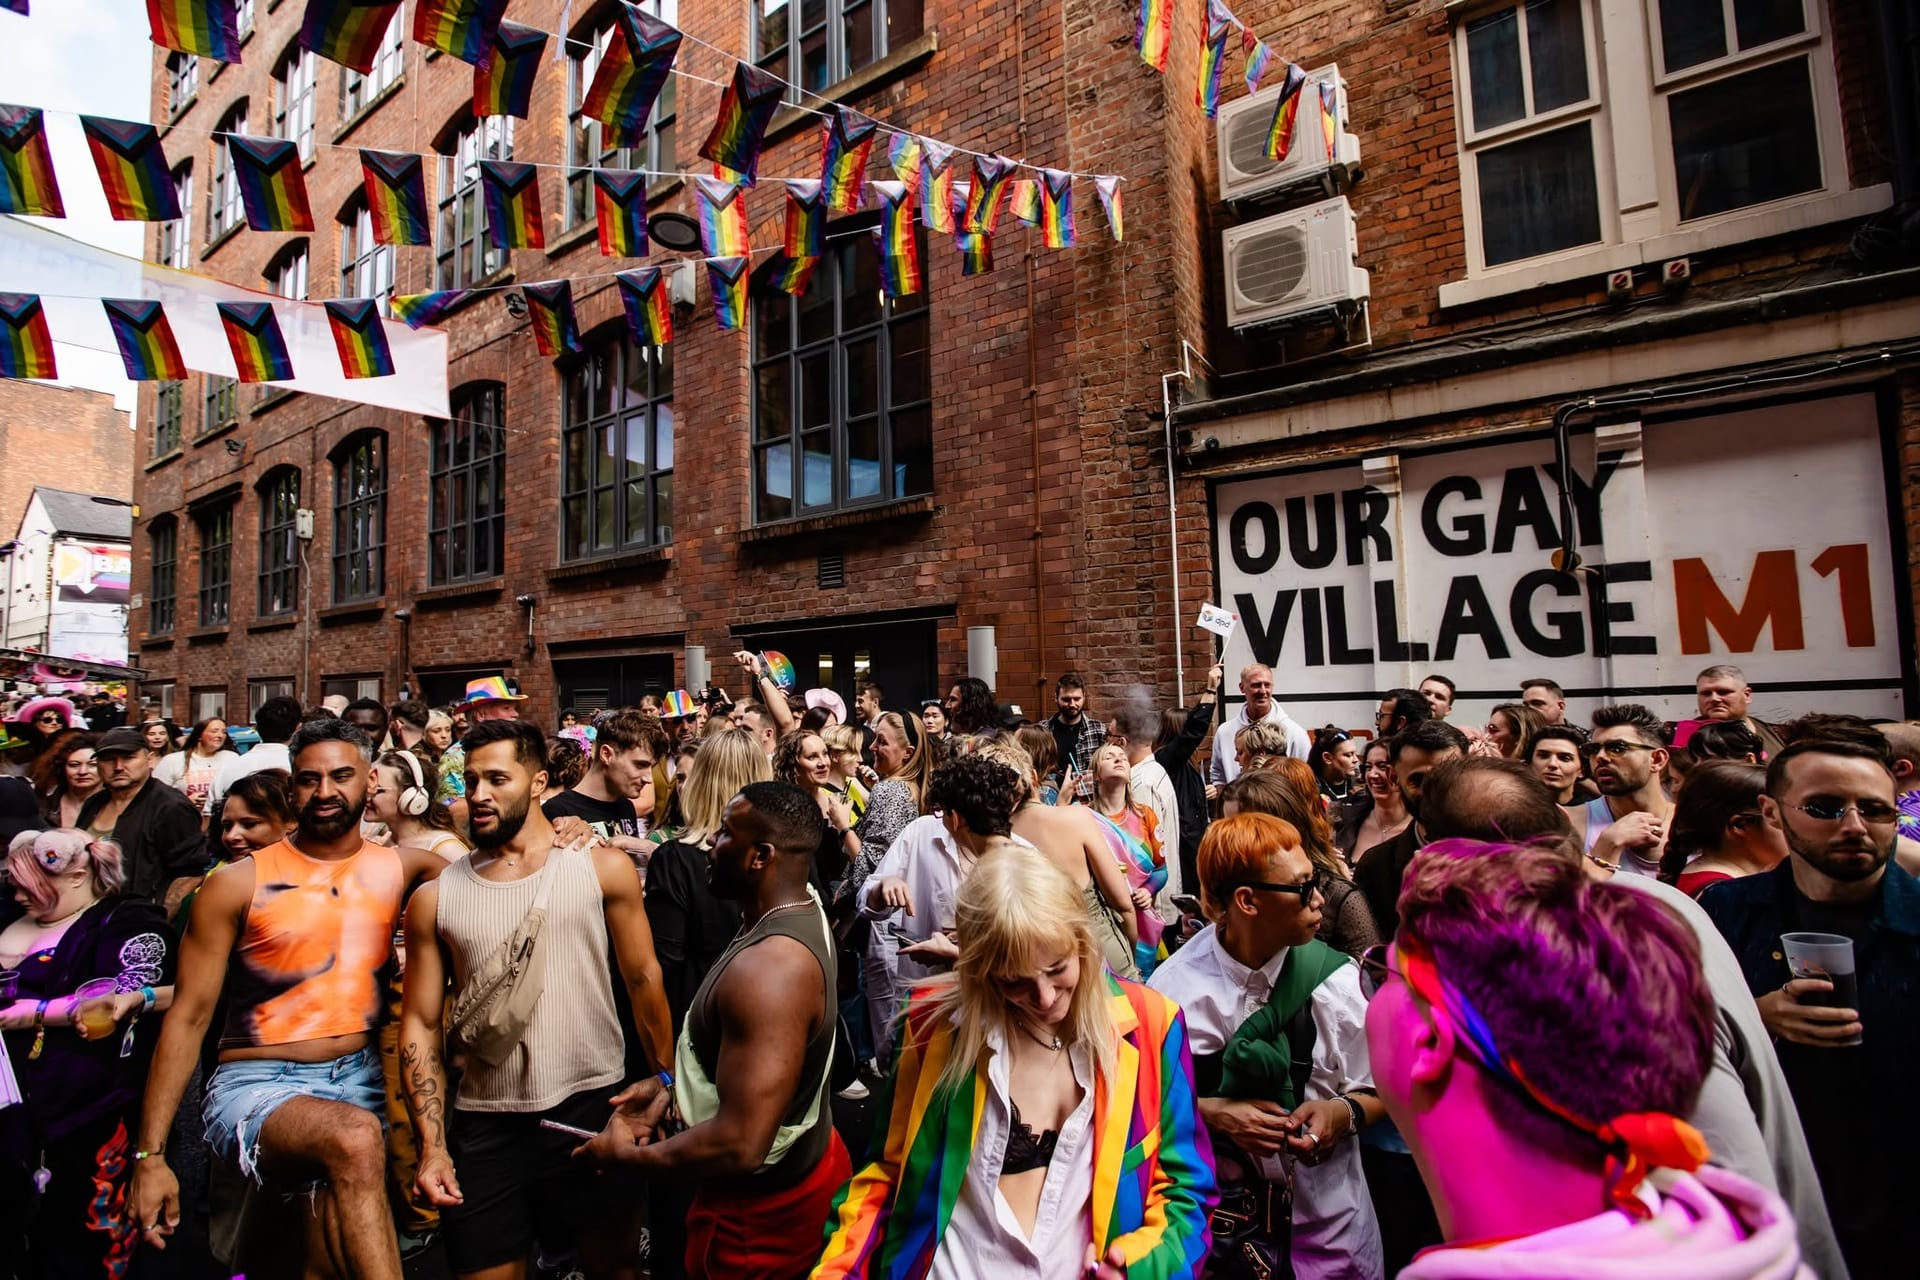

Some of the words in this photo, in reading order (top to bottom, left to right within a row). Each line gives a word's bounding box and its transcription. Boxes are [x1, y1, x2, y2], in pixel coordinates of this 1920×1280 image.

[1229, 485, 1394, 575] OUR
[1421, 450, 1625, 557] GAY
[1216, 617, 1230, 628] dpd
[1234, 560, 1658, 669] VILLAGE
[1671, 543, 1876, 656] M1
[779, 668, 791, 686] FAN
